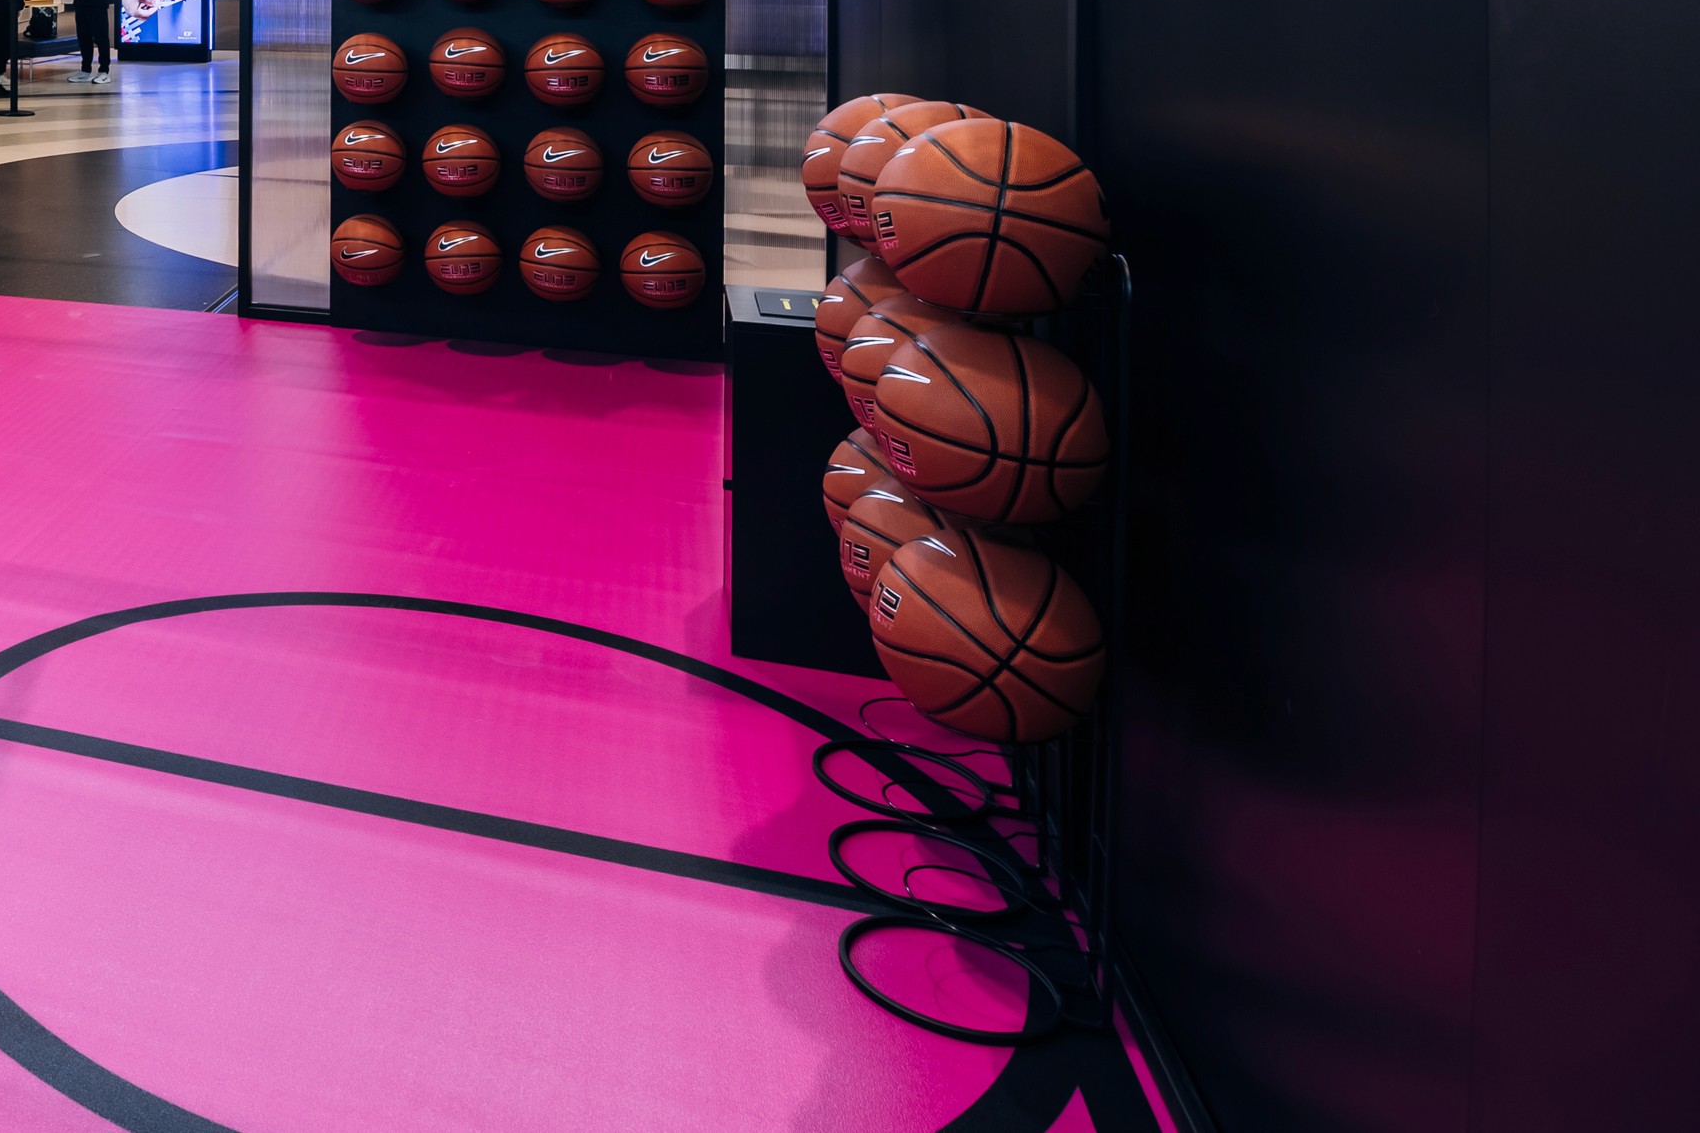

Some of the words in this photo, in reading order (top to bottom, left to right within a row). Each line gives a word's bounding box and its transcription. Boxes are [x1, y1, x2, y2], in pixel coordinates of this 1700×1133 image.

[444, 69, 486, 82] ELITE
[546, 75, 589, 88] ELITE
[644, 74, 690, 87] ELITE
[343, 157, 383, 170] ELITE
[437, 164, 479, 177] ELITE
[543, 173, 587, 187] ELITE
[650, 176, 696, 189] ELITE
[642, 279, 687, 292] ELITE
